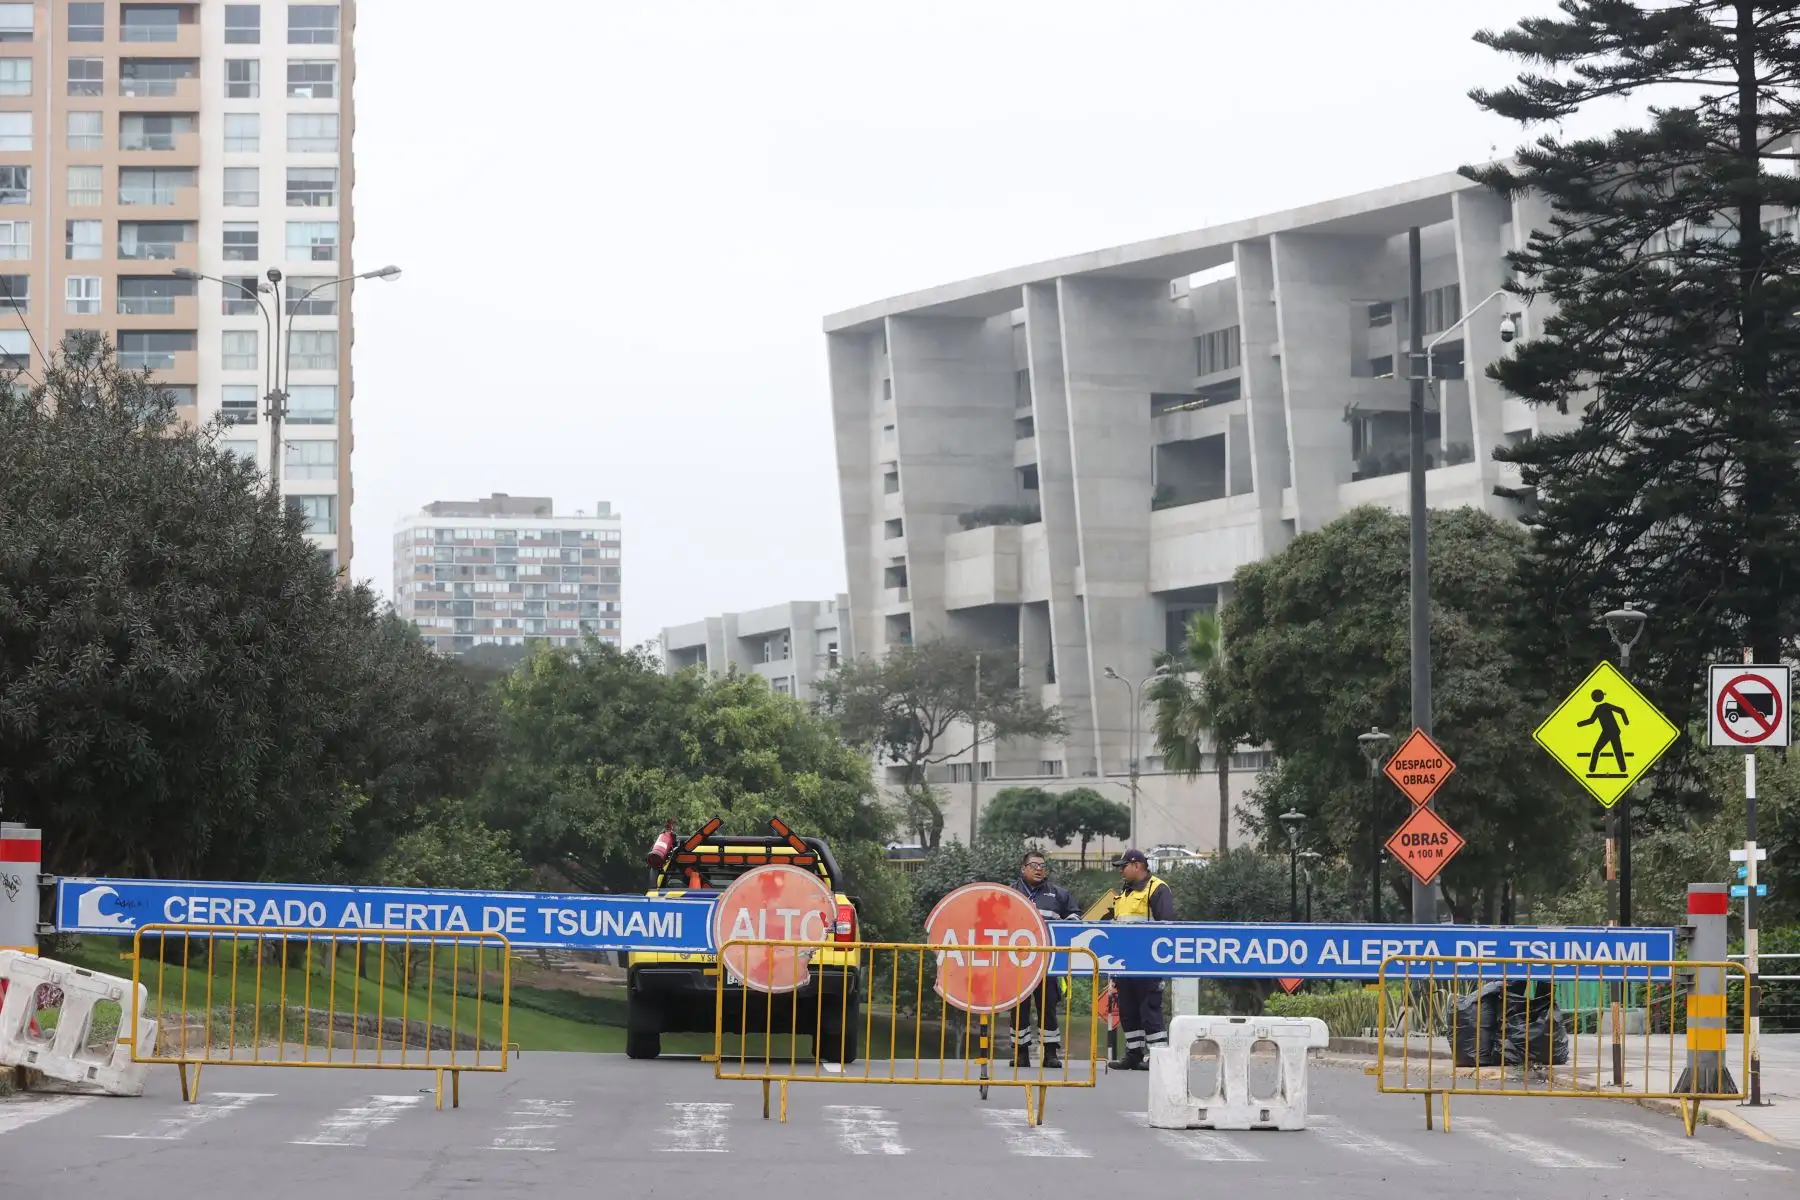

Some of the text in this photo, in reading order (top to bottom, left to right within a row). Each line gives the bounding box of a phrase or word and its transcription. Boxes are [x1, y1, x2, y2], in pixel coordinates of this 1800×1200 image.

[1395, 759, 1442, 770] DESPACIO
[1403, 774, 1436, 785] OBRAS
[1401, 832, 1448, 846] OBRAS
[1408, 849, 1443, 858] A 100 M
[338, 902, 469, 931] ALERTA
[483, 906, 526, 933] DE
[538, 908, 682, 938] TSUNAMI
[936, 928, 1037, 967] ALTO
[1317, 939, 1445, 966] ALERTA
[1456, 940, 1497, 966] DE
[1510, 941, 1647, 967] TSUNAMI
